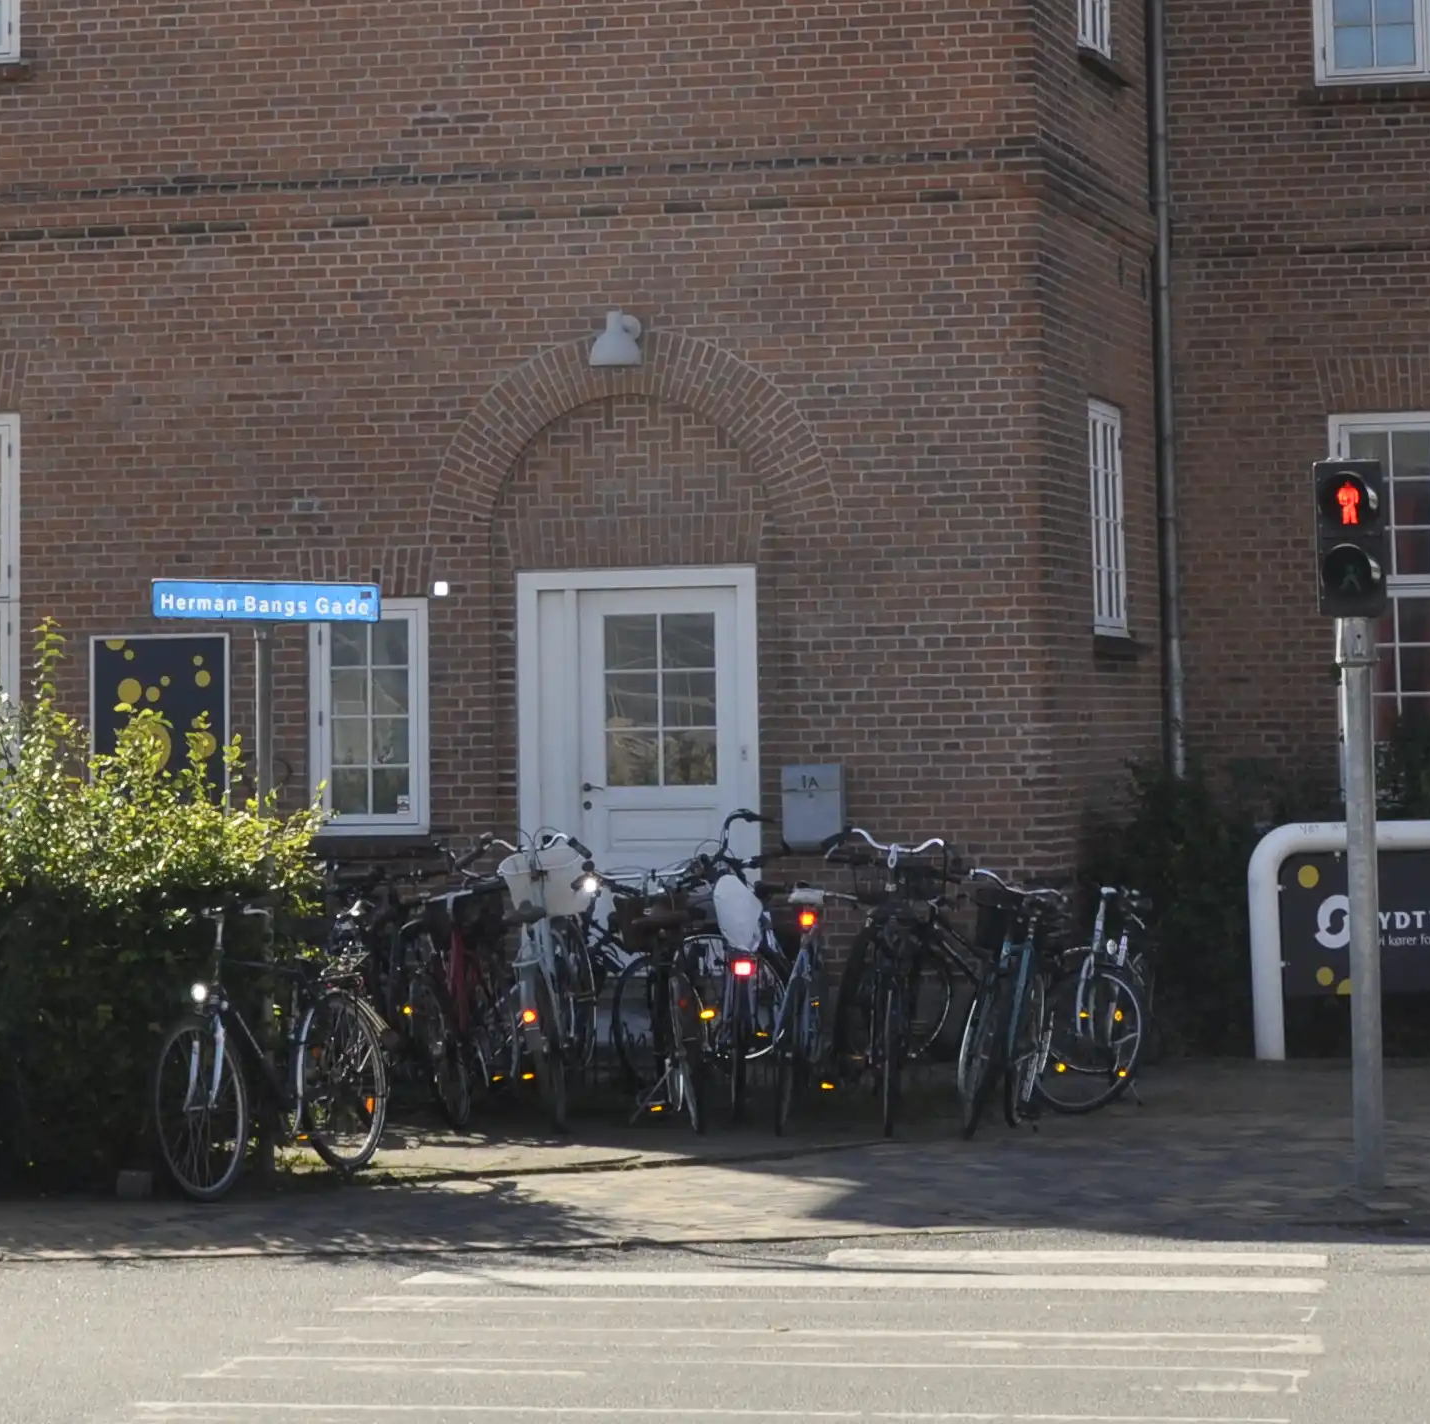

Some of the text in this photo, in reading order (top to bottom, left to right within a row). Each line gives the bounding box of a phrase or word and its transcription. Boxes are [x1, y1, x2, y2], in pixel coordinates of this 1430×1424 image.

[160, 593, 370, 616] Herman Bangs Gade
[801, 775, 819, 789] 1A
[1388, 935, 1417, 946] kører
